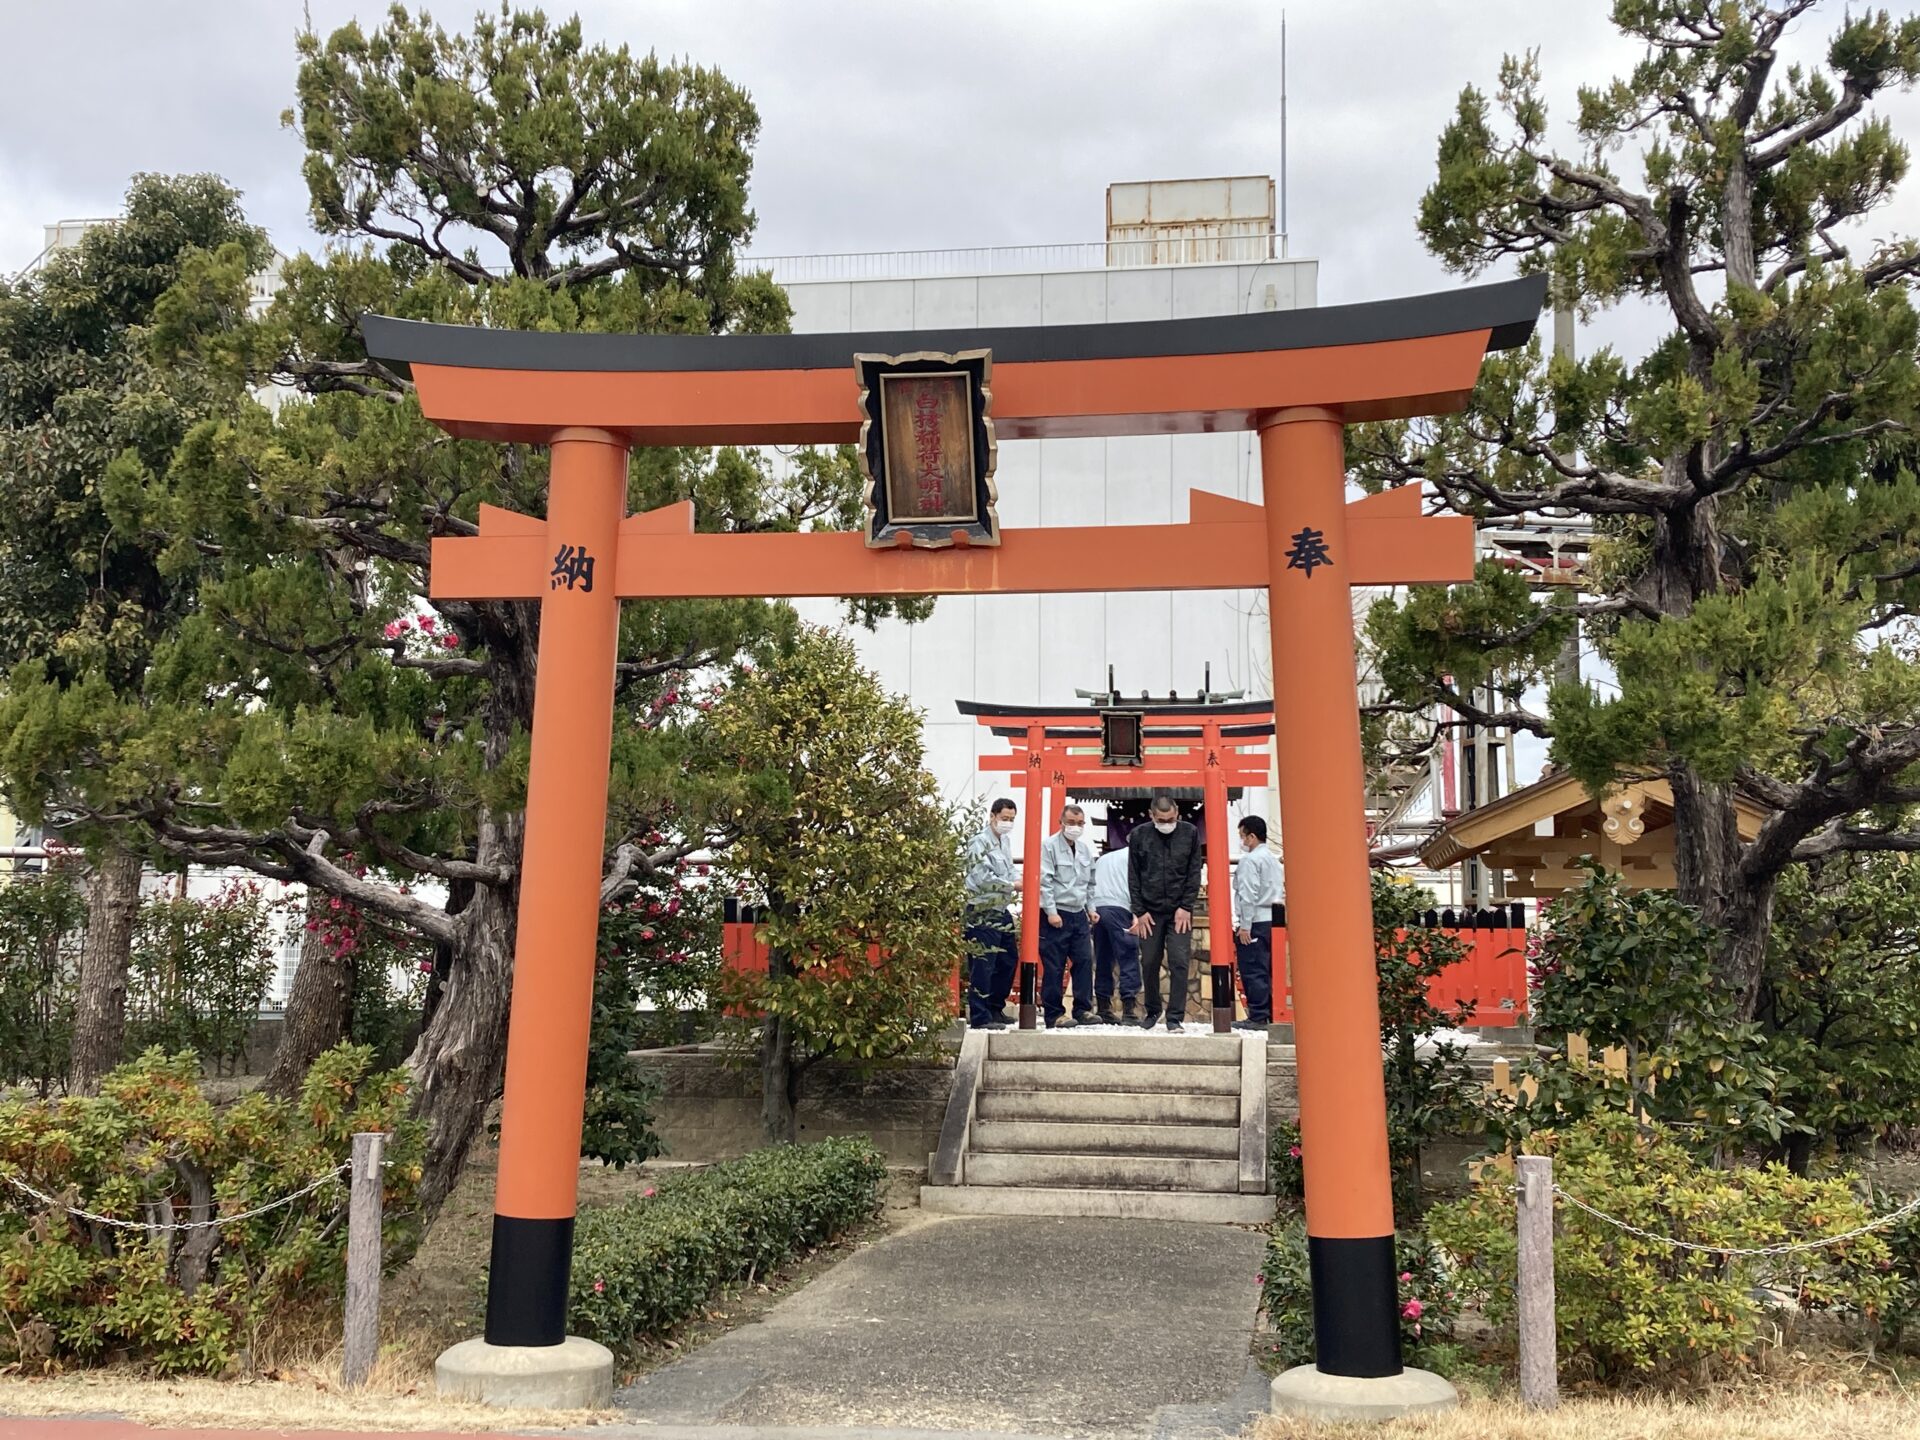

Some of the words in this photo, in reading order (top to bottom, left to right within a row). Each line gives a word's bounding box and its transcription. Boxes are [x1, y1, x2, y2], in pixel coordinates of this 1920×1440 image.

[1284, 526, 1334, 579] 奉
[551, 543, 595, 593] 納
[1028, 752, 1041, 769] 納
[1206, 749, 1220, 768] 奉
[1053, 770, 1065, 785] 納
